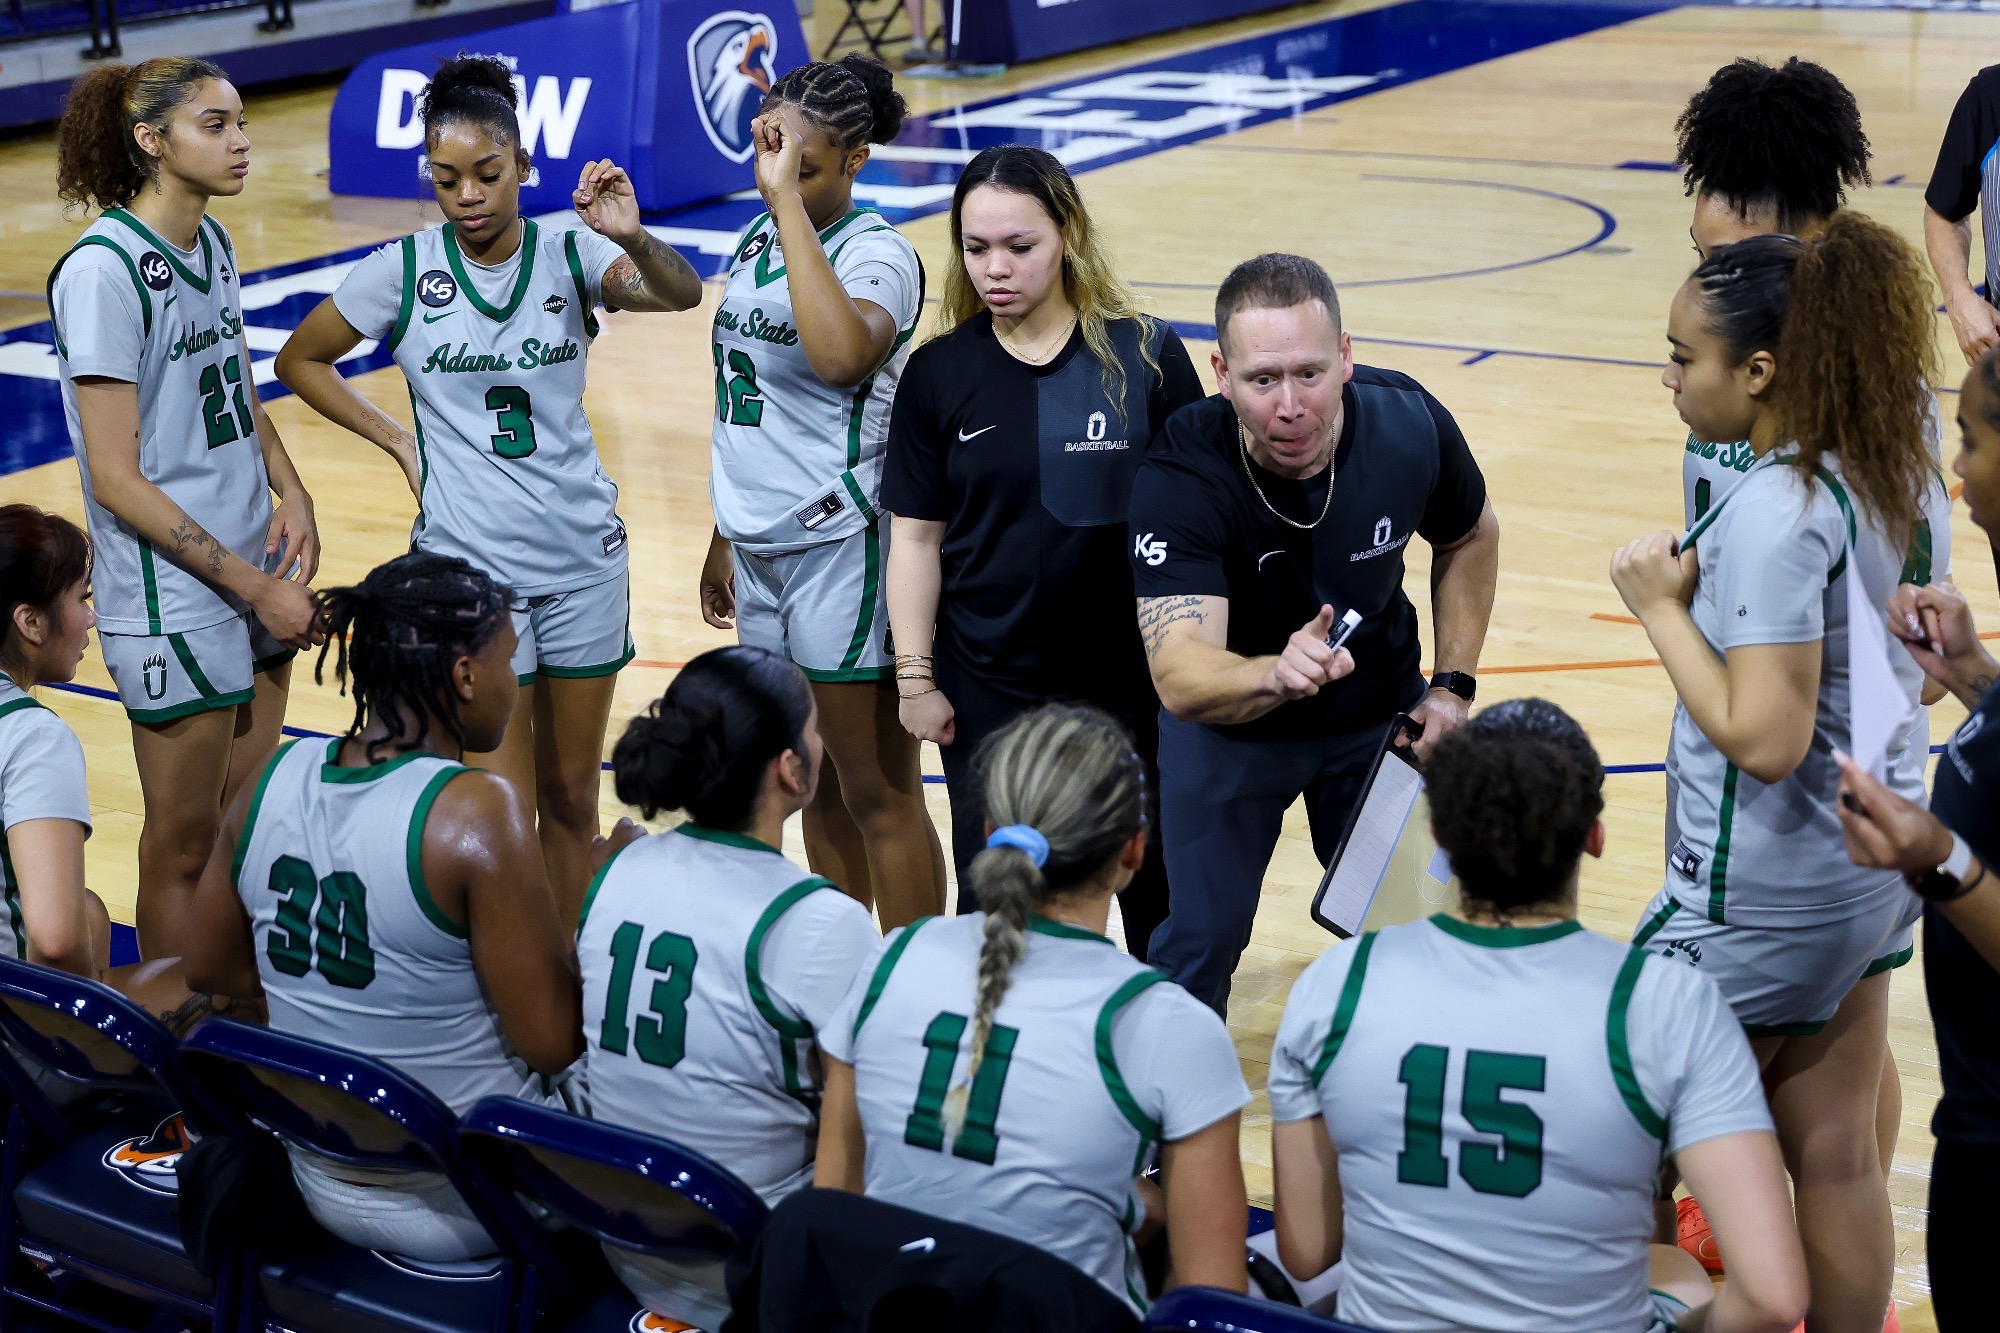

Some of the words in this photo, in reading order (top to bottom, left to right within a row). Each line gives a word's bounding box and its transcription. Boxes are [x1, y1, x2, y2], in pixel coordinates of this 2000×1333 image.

[376, 68, 593, 160] DW
[143, 258, 170, 284] K5
[421, 277, 453, 300] K5
[544, 299, 568, 311] RMAC
[170, 320, 219, 361] Adams
[740, 307, 799, 347] State
[421, 342, 513, 374] Adams
[517, 337, 579, 370] State
[715, 342, 765, 427] 12
[484, 385, 538, 460] 3
[1064, 440, 1130, 452] BASKETBALL
[1134, 532, 1168, 566] K5
[267, 853, 377, 990] 30
[599, 920, 699, 1069] 13
[904, 1010, 1020, 1166] 11
[1396, 1042, 1546, 1198] 15
